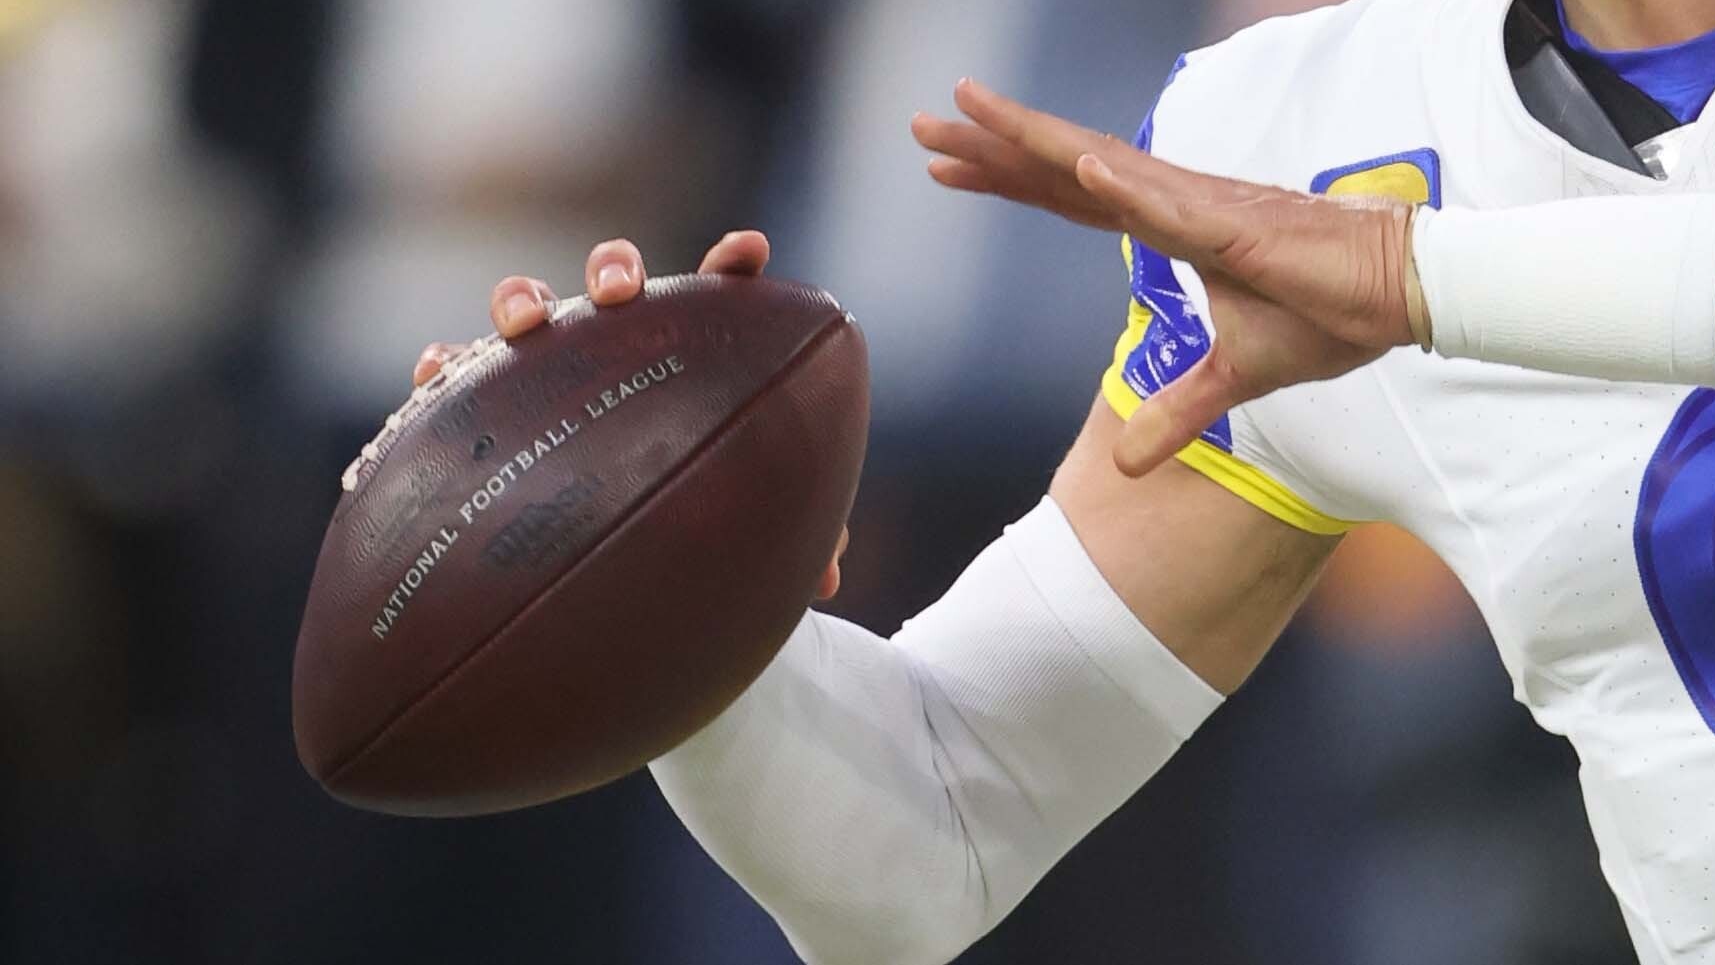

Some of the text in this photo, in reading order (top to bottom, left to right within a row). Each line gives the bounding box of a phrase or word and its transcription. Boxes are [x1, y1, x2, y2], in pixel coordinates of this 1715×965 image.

[370, 527, 459, 641] NATIONAL
[459, 418, 581, 525] FOOTBALL
[584, 355, 686, 420] LEAGUE
